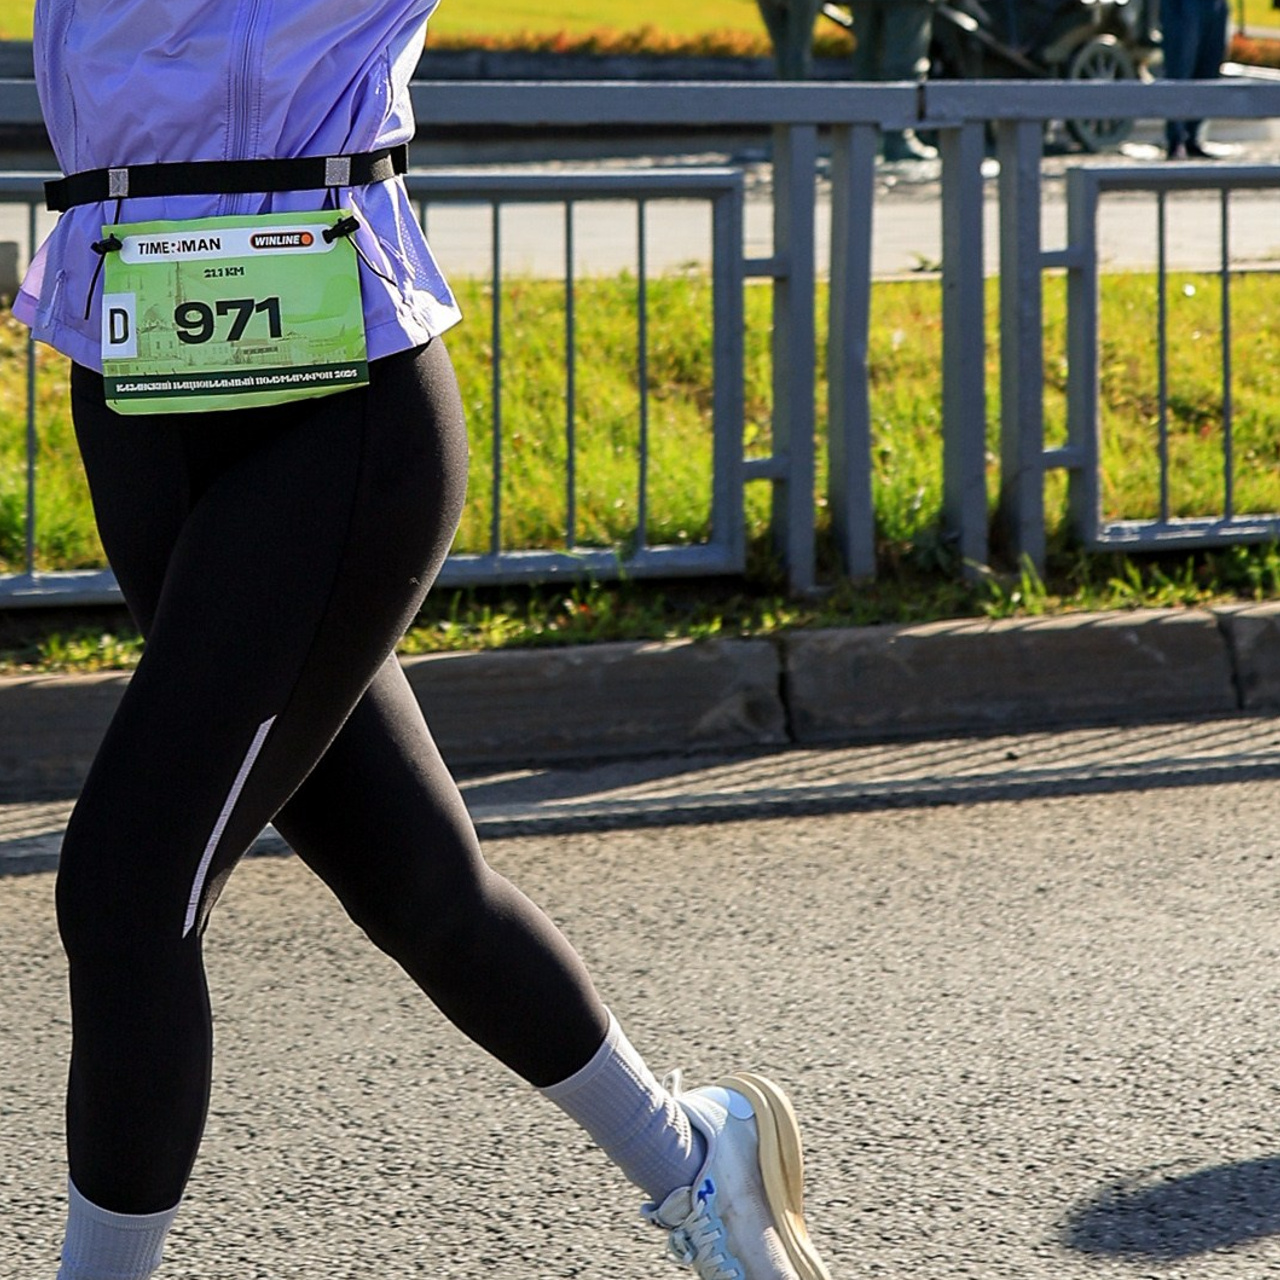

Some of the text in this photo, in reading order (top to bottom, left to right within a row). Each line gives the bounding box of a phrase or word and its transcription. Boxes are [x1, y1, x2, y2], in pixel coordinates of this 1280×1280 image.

[254, 234, 301, 247] WINLINE
[109, 308, 129, 345] D
[174, 296, 283, 345] 971
